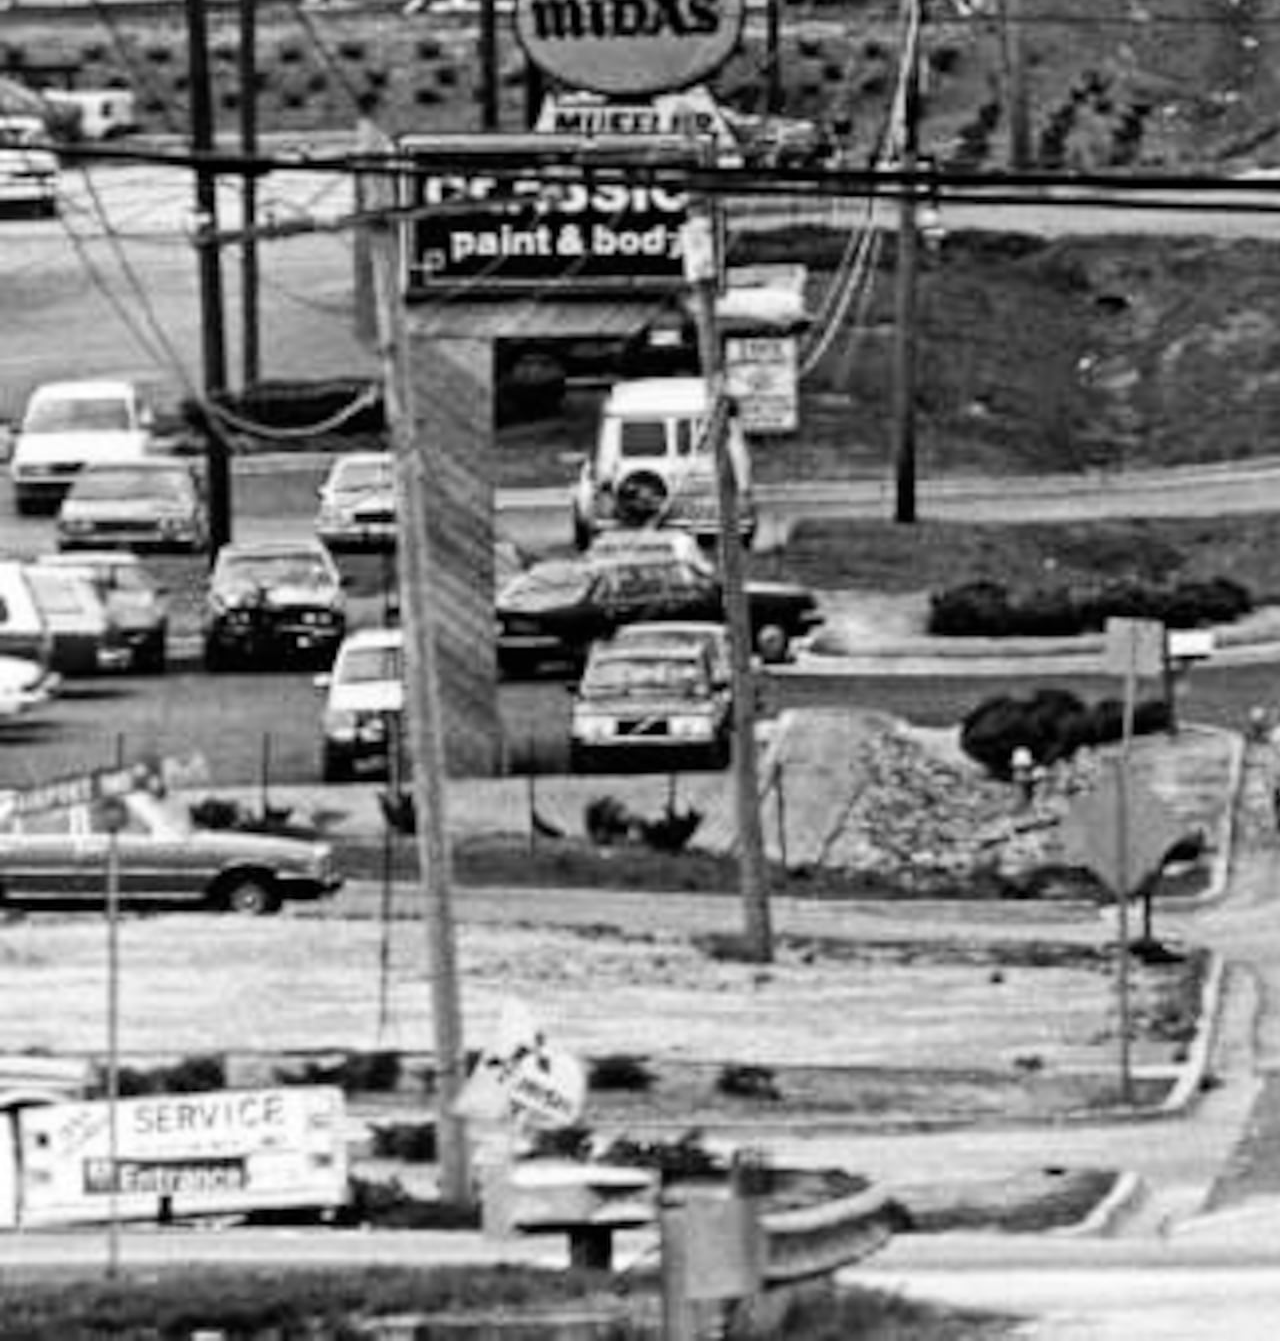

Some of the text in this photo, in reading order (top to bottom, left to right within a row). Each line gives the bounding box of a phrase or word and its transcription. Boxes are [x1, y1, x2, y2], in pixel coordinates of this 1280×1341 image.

[451, 223, 551, 261] paint
[556, 223, 585, 256] &
[133, 1096, 284, 1134] SERVICE
